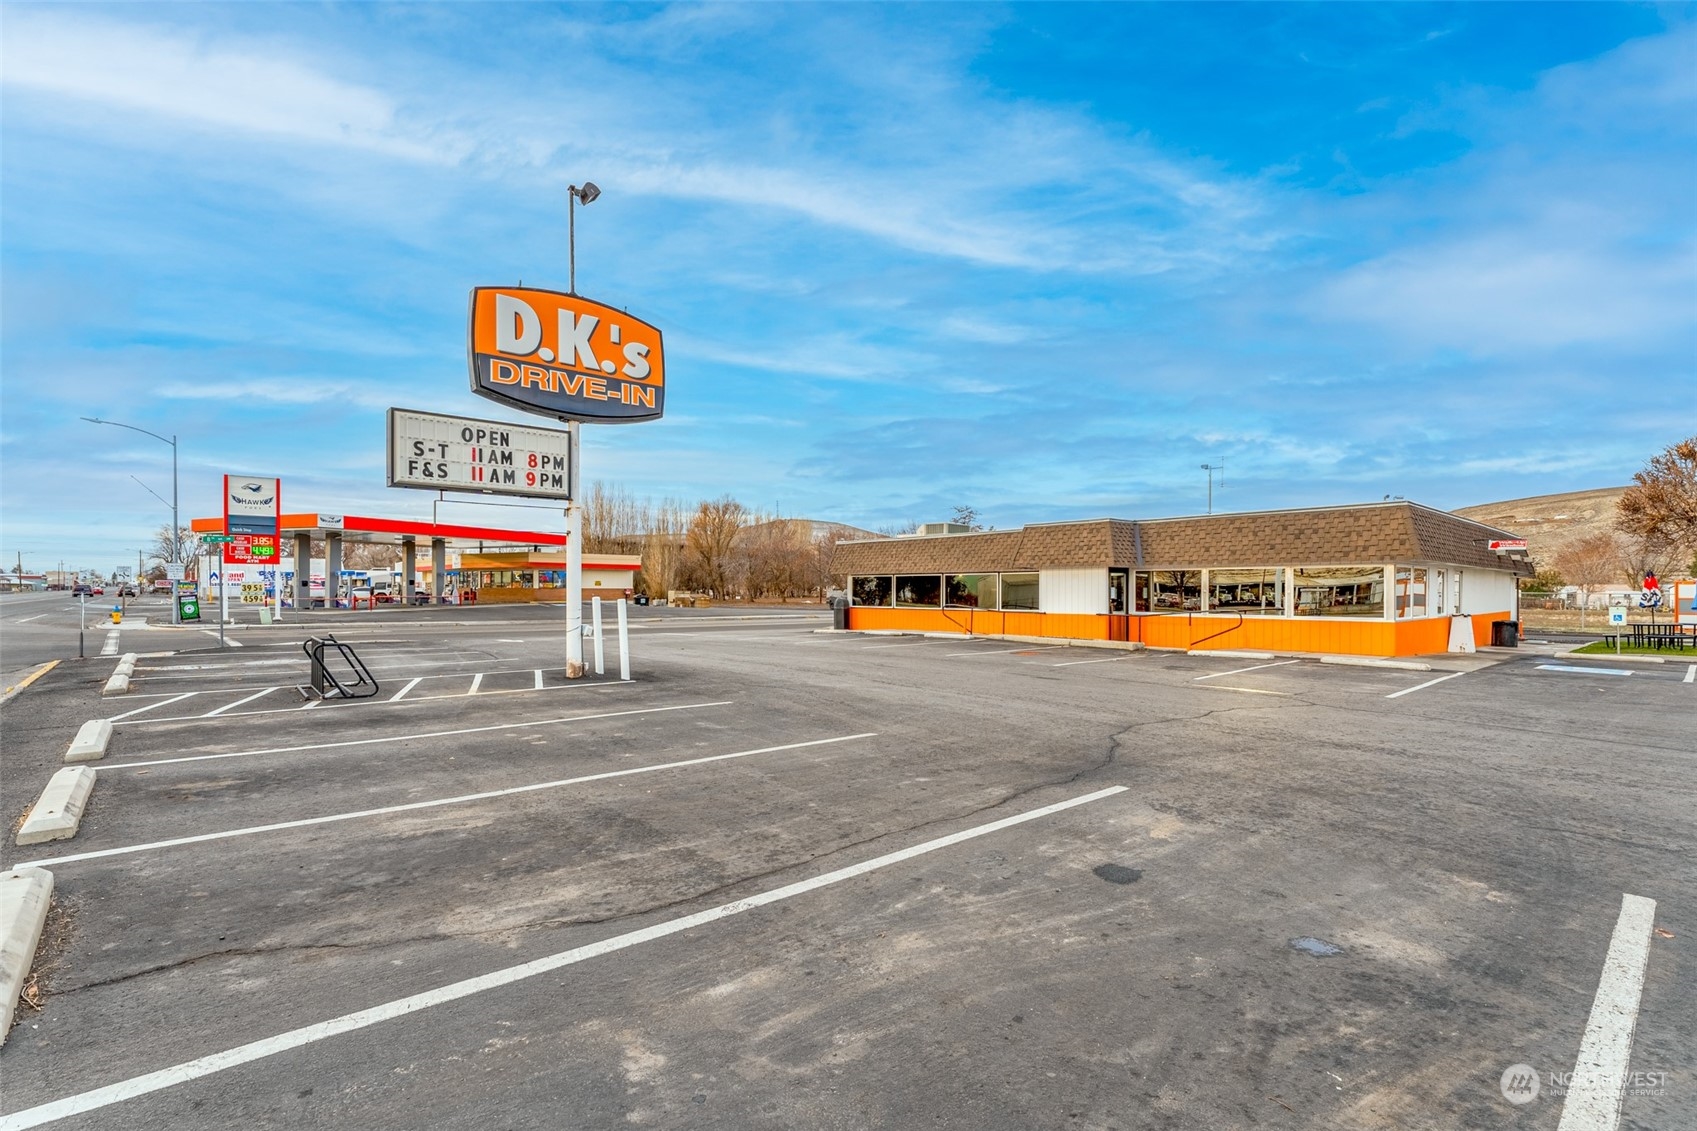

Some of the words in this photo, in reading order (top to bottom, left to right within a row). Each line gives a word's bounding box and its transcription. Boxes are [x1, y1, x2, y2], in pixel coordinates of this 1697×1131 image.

[495, 293, 650, 379] D.K.'s
[490, 358, 656, 408] DRIVE-IN
[461, 427, 510, 447] OPEN
[413, 441, 449, 459] S-T
[408, 460, 449, 479] F&S
[241, 498, 265, 506] HAWK
